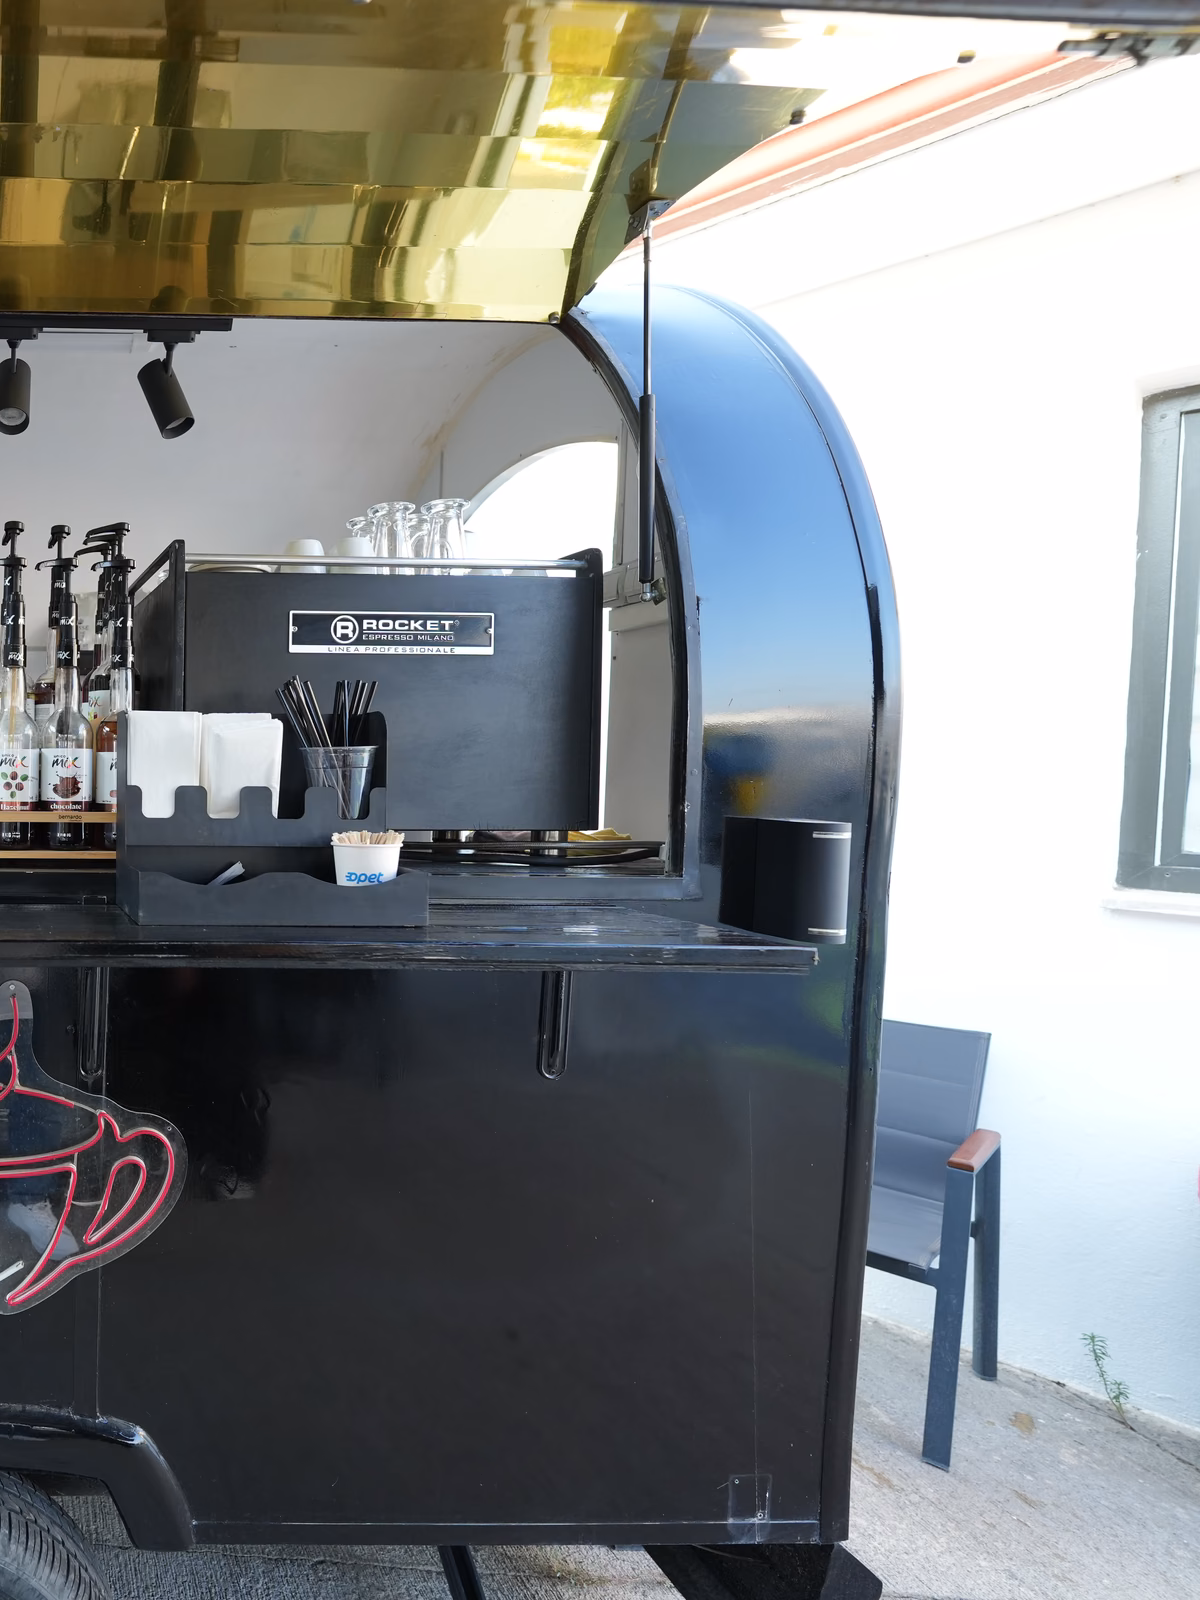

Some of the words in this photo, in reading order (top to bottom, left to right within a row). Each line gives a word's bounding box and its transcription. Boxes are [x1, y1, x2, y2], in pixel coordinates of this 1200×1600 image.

[362, 619, 454, 631] ROCKET
[417, 634, 455, 642] MILANO
[364, 646, 456, 654] PROFESSIONALE
[50, 802, 82, 810] chocolate
[345, 871, 384, 885] opet
